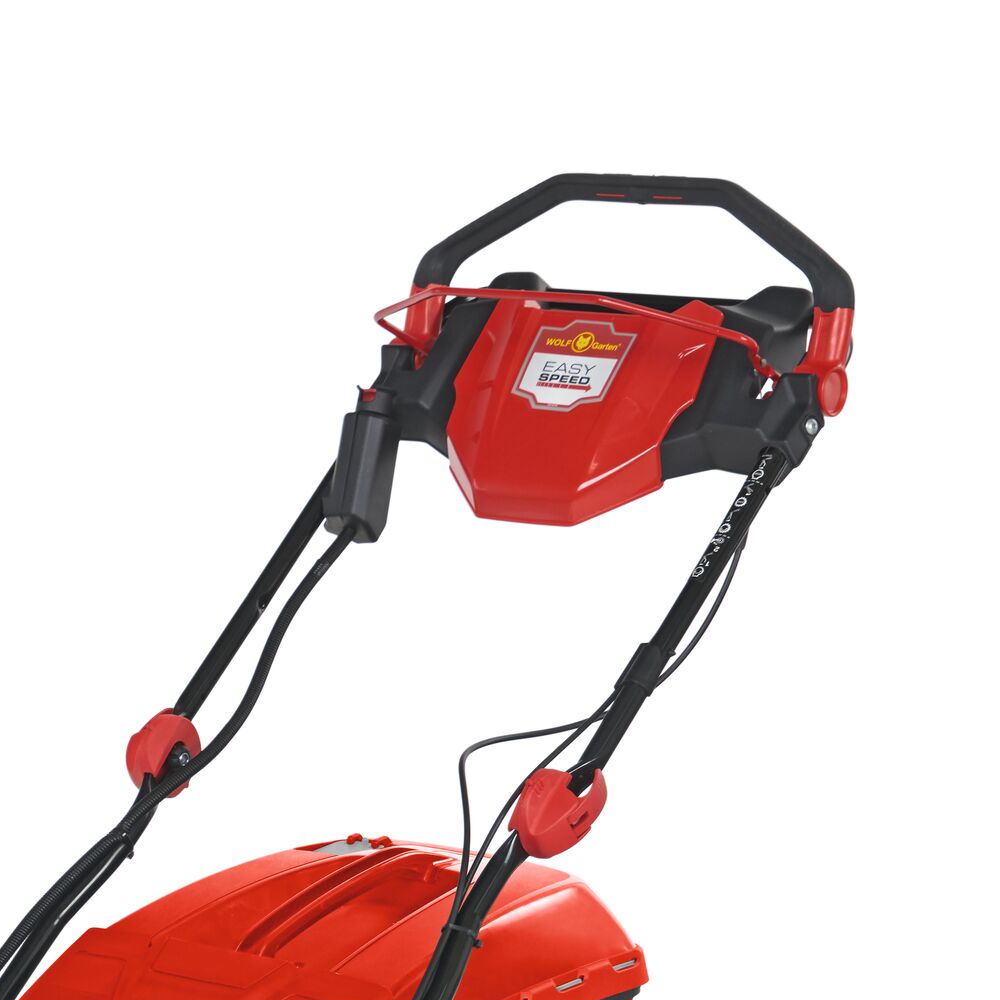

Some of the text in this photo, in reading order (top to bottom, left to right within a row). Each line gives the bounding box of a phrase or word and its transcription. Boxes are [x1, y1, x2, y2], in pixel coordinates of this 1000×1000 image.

[546, 338, 572, 347] WOLF
[542, 361, 597, 375] EASY
[538, 373, 590, 385] SPEED
